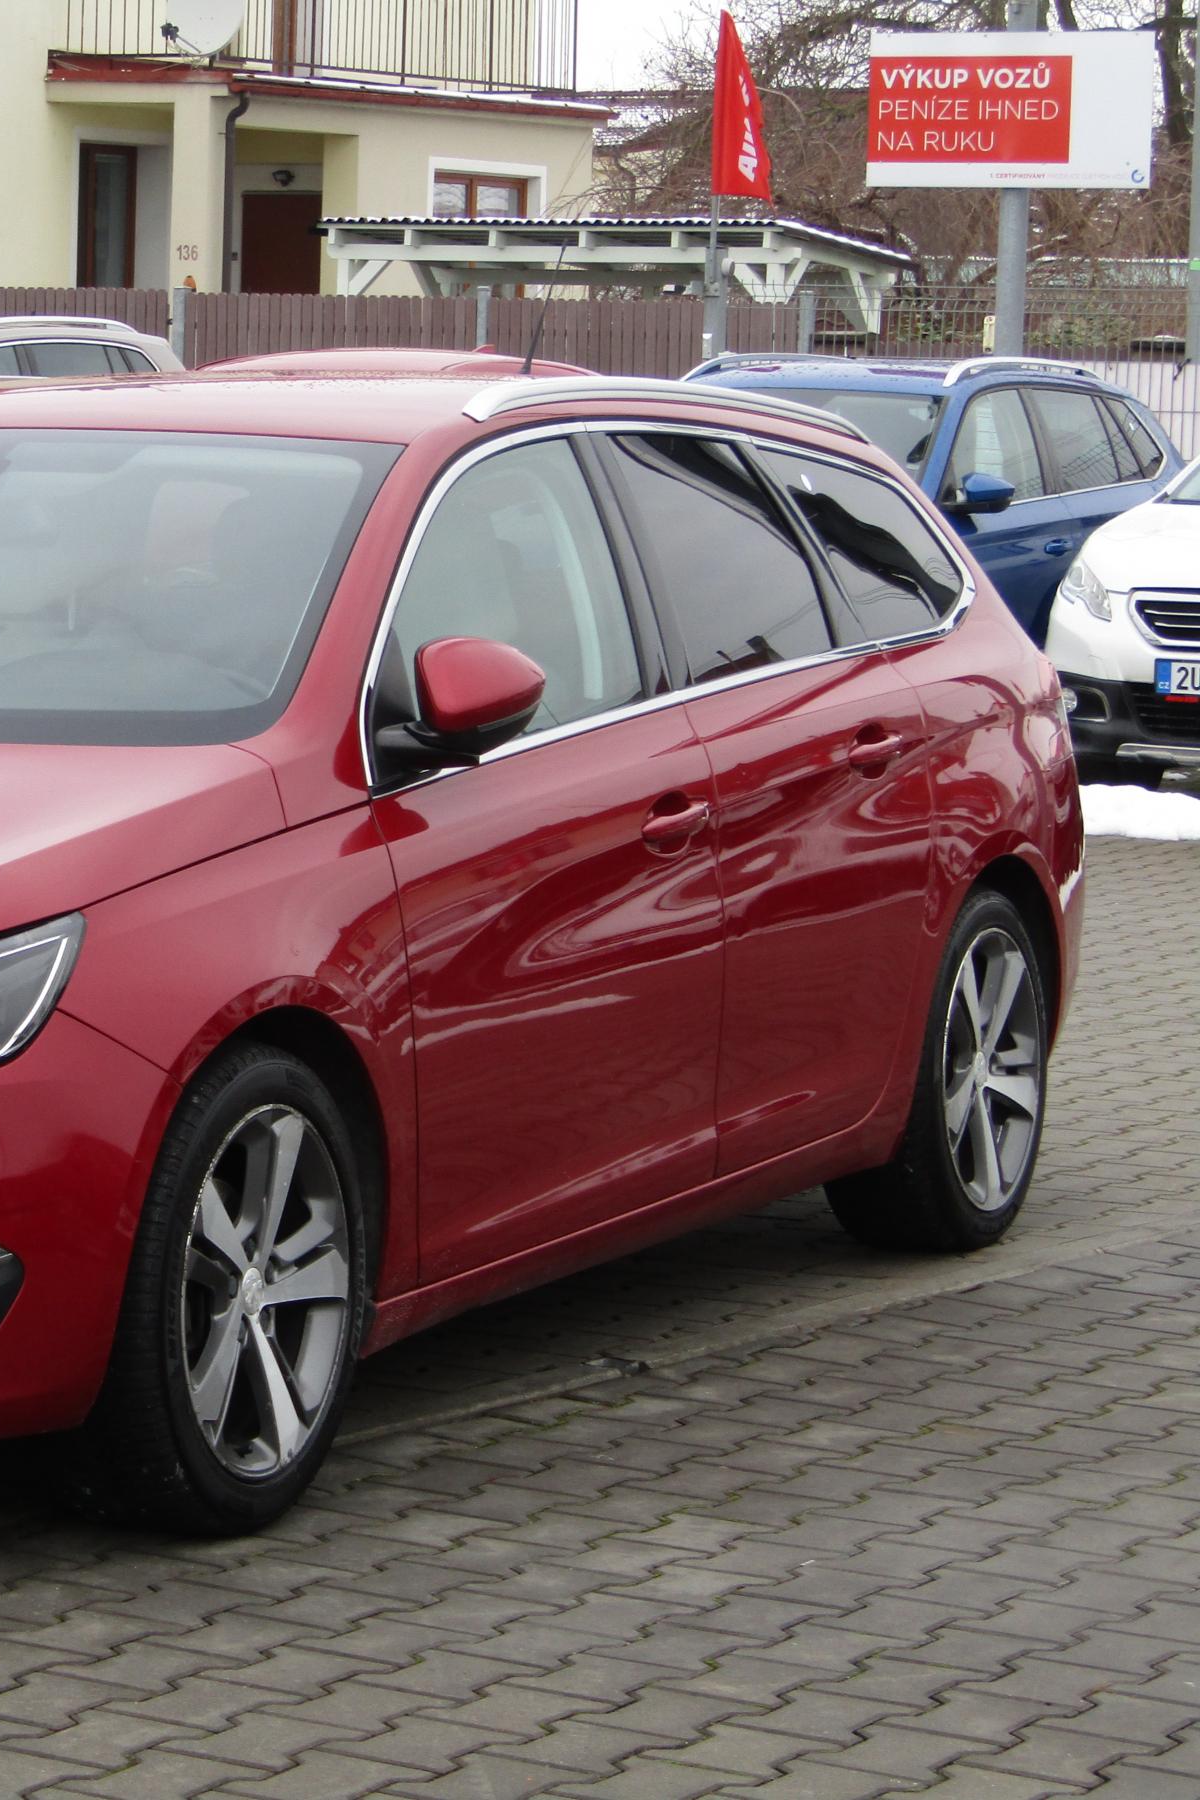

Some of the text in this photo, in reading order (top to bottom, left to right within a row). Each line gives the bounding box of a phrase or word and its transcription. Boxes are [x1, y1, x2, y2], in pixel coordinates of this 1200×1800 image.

[880, 62, 1051, 89] VÝKUP VOZŮ
[878, 95, 1059, 121] PENÍZE IHNED
[877, 131, 995, 152] NA RUKU
[176, 244, 199, 261] 136
